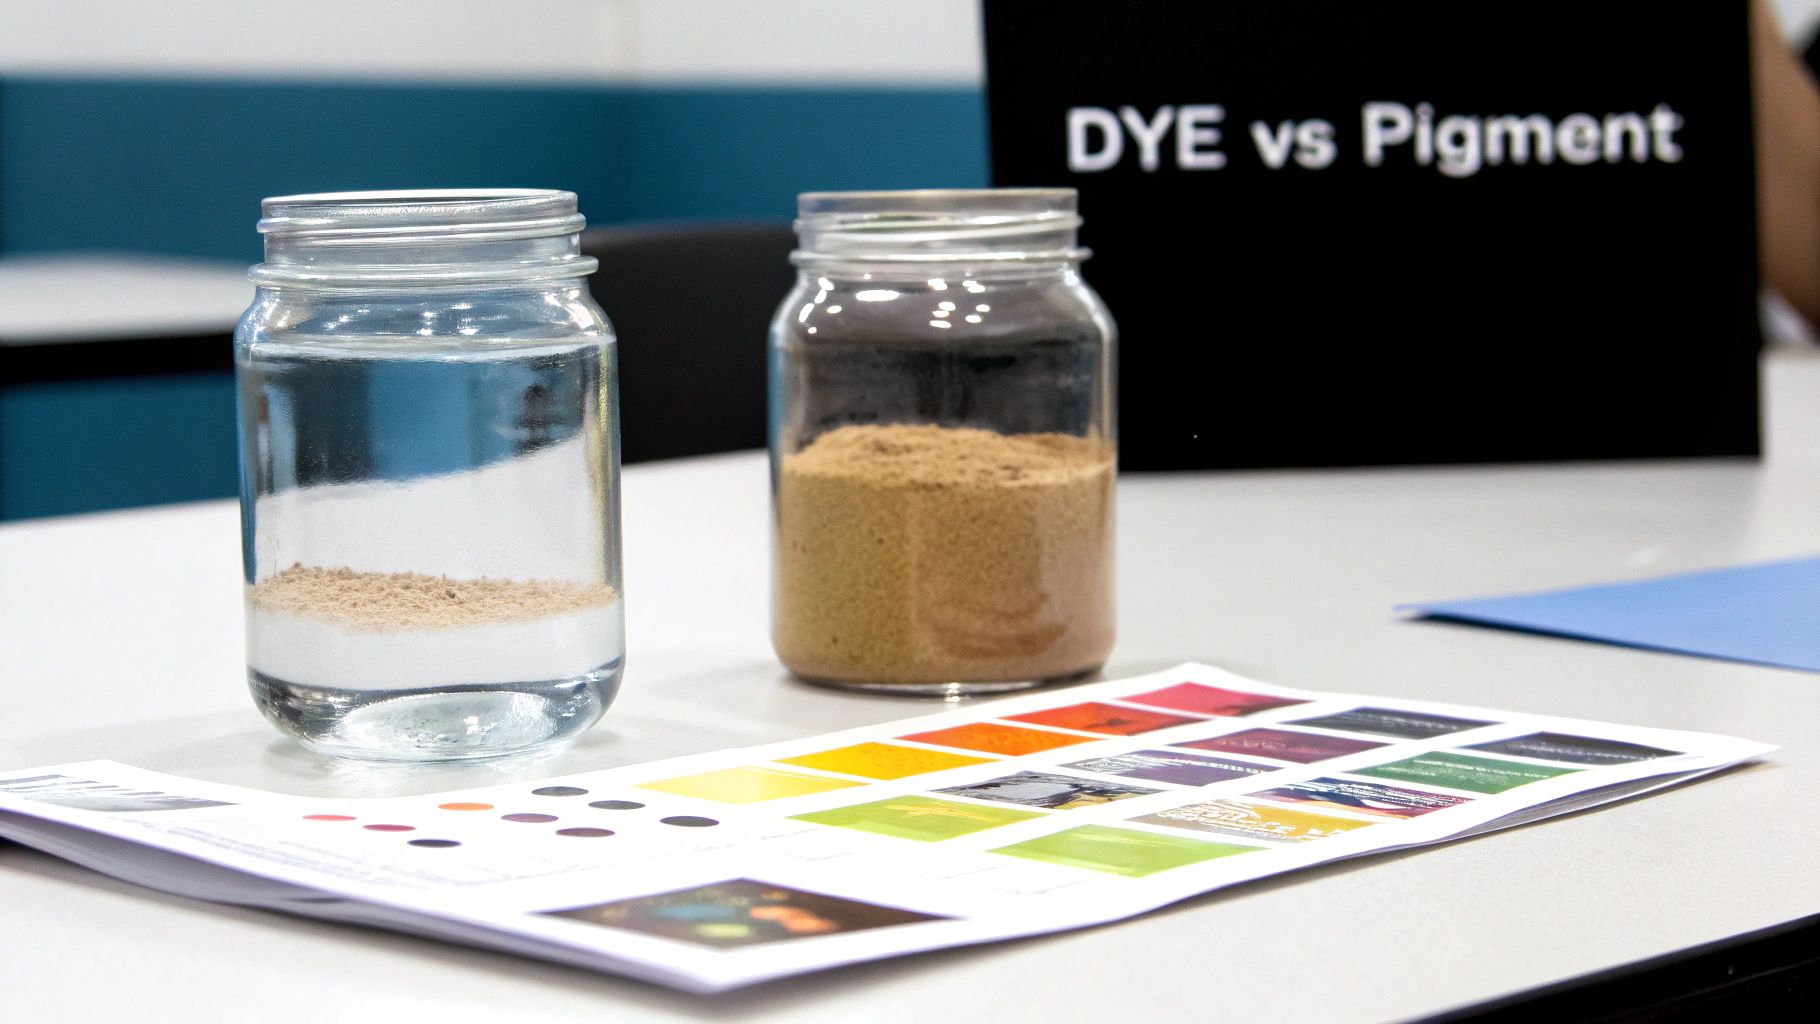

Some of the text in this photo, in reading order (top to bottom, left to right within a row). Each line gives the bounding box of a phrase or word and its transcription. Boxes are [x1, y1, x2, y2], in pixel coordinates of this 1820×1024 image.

[1067, 102, 1683, 177] DYE vs Pigment
